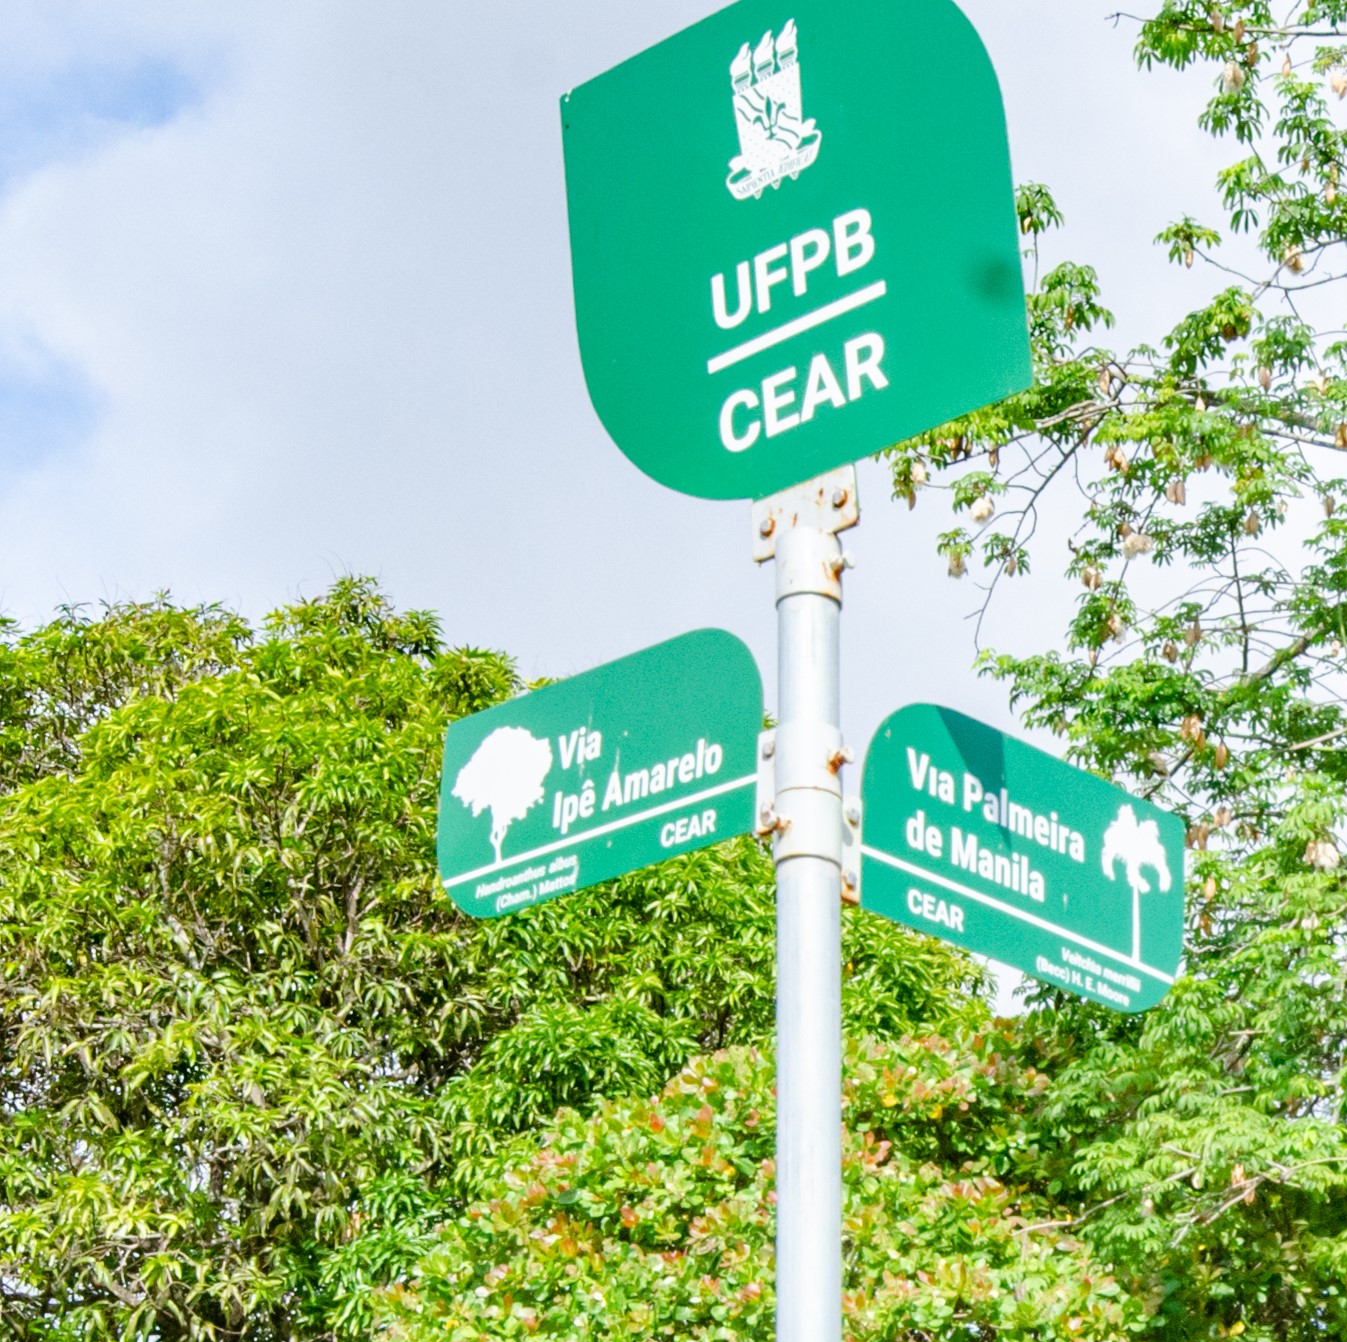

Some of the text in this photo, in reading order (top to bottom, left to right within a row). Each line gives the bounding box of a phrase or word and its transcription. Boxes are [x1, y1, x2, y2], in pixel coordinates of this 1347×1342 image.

[711, 209, 875, 329] UFPB
[719, 332, 889, 452] CEAR
[553, 738, 723, 835] Ipê Amarelo
[558, 727, 602, 770] Via
[660, 809, 716, 848] CEAR
[907, 747, 1085, 863] Via Palmeira
[906, 810, 1045, 903] de Manila
[907, 889, 964, 932] CEAR
